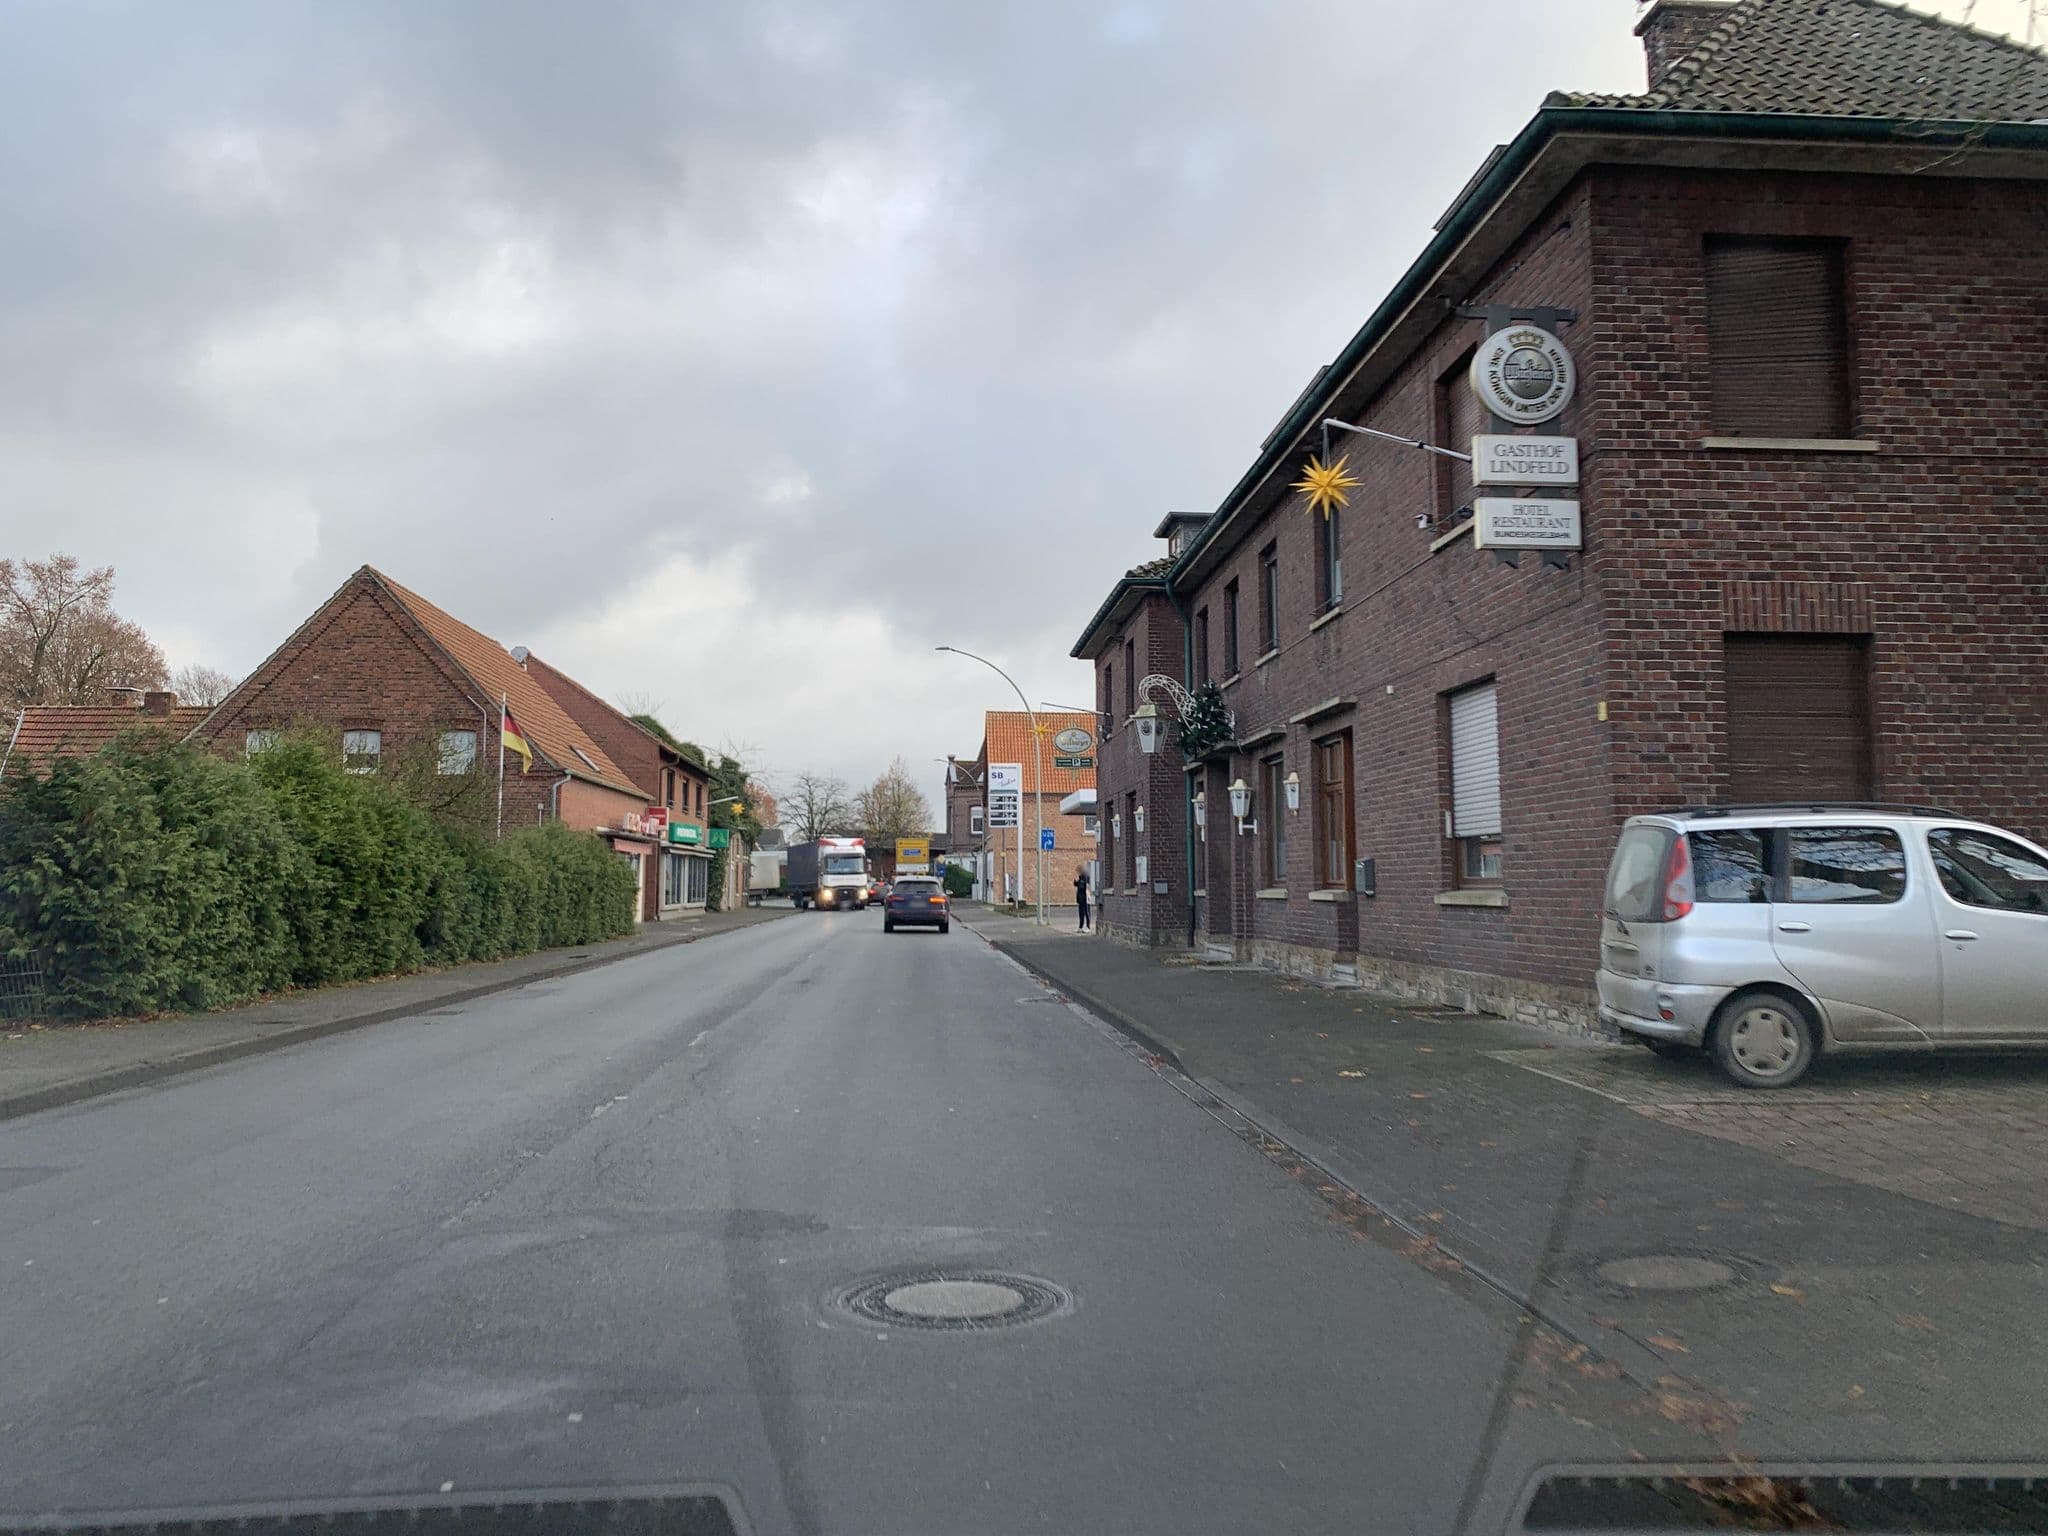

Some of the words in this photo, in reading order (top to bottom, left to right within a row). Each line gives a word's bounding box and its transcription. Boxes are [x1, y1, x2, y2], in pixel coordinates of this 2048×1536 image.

[1514, 400, 1548, 413] UNTER
[1547, 384, 1564, 405] DEN
[1493, 443, 1567, 458] GASTHOF
[1490, 460, 1570, 474] LINDFELD
[1512, 504, 1552, 516] HOTEL
[1492, 516, 1574, 529] RESTAURANT
